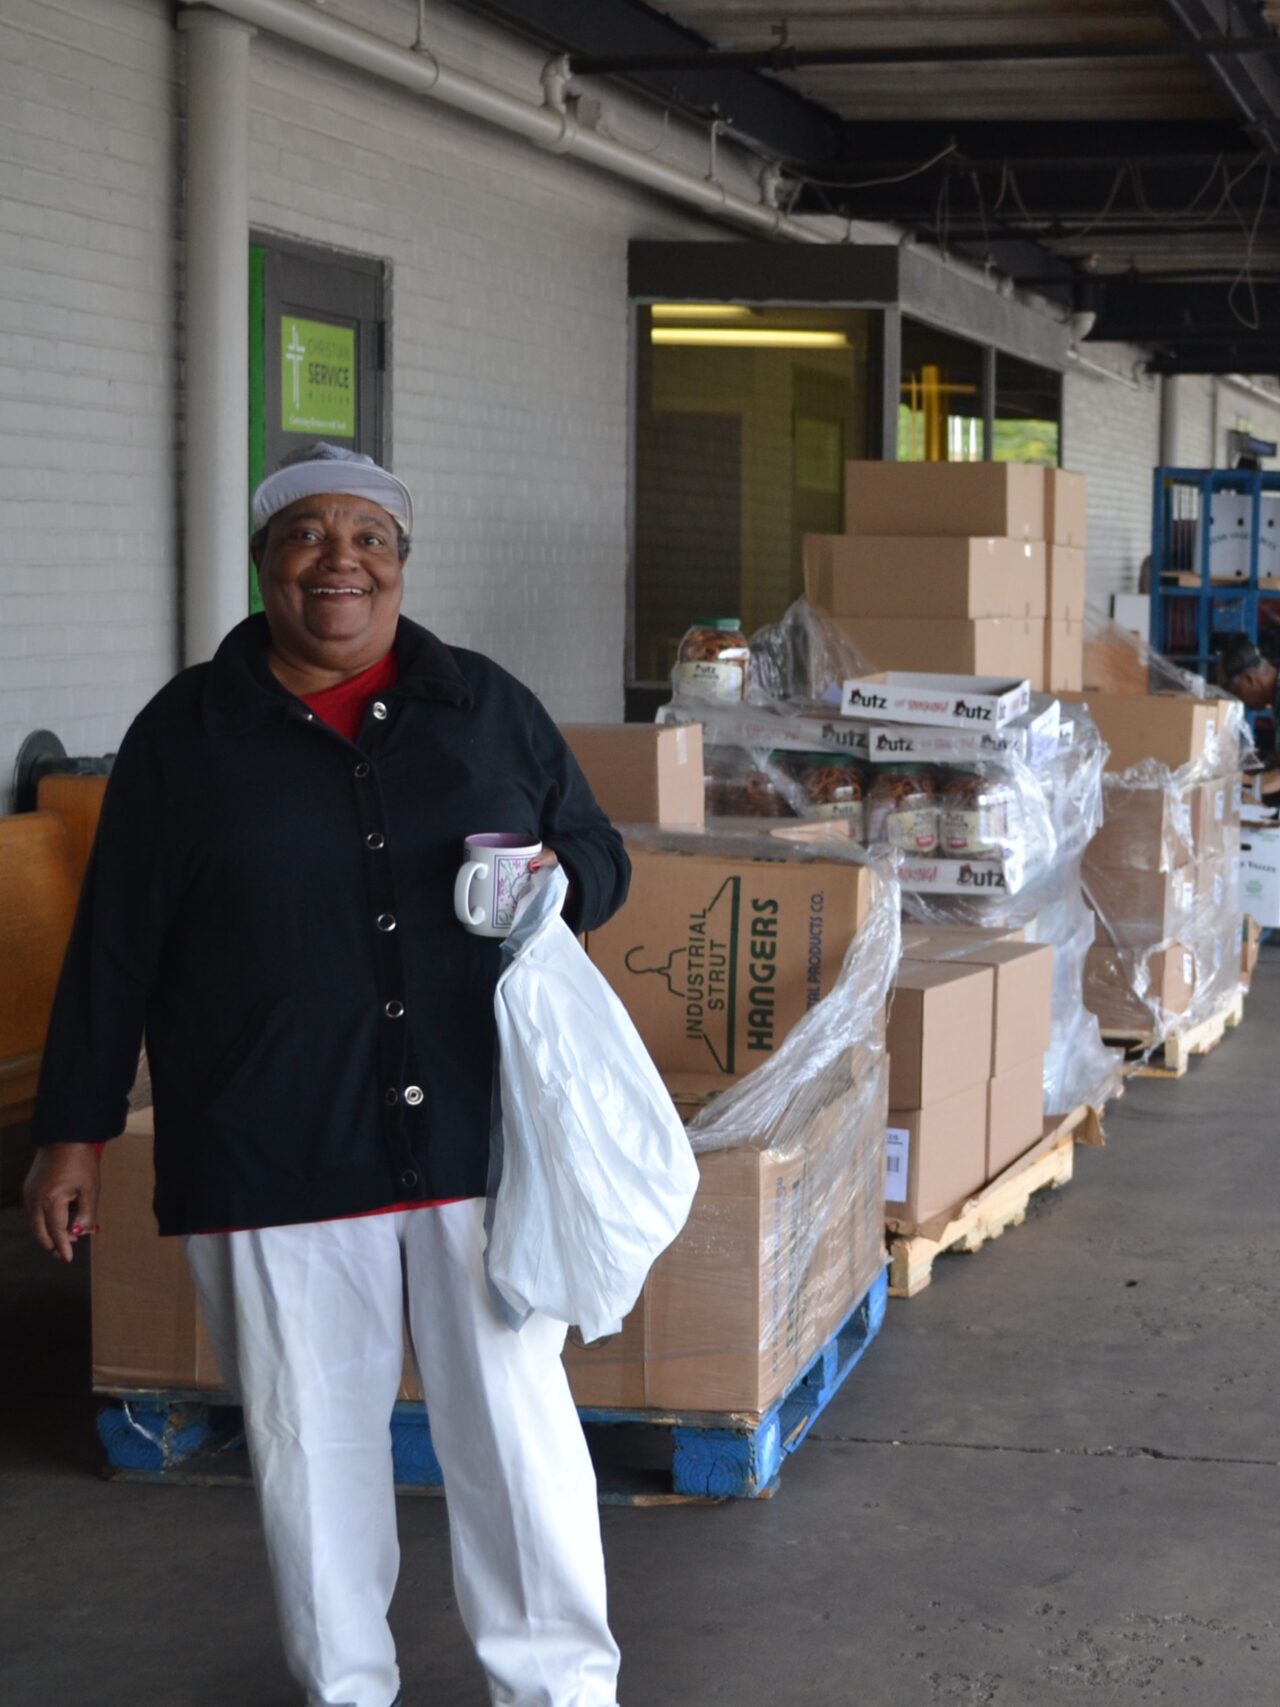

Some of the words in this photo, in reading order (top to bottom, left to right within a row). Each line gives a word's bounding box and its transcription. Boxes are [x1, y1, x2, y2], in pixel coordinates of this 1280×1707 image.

[308, 362, 350, 389] SERVICE
[810, 889, 825, 913] CO.
[686, 908, 707, 1040] INDUSTRIAL
[708, 939, 726, 1012] STRUT
[747, 898, 779, 1051] HANGERS
[807, 916, 824, 984] PRODUCTS
